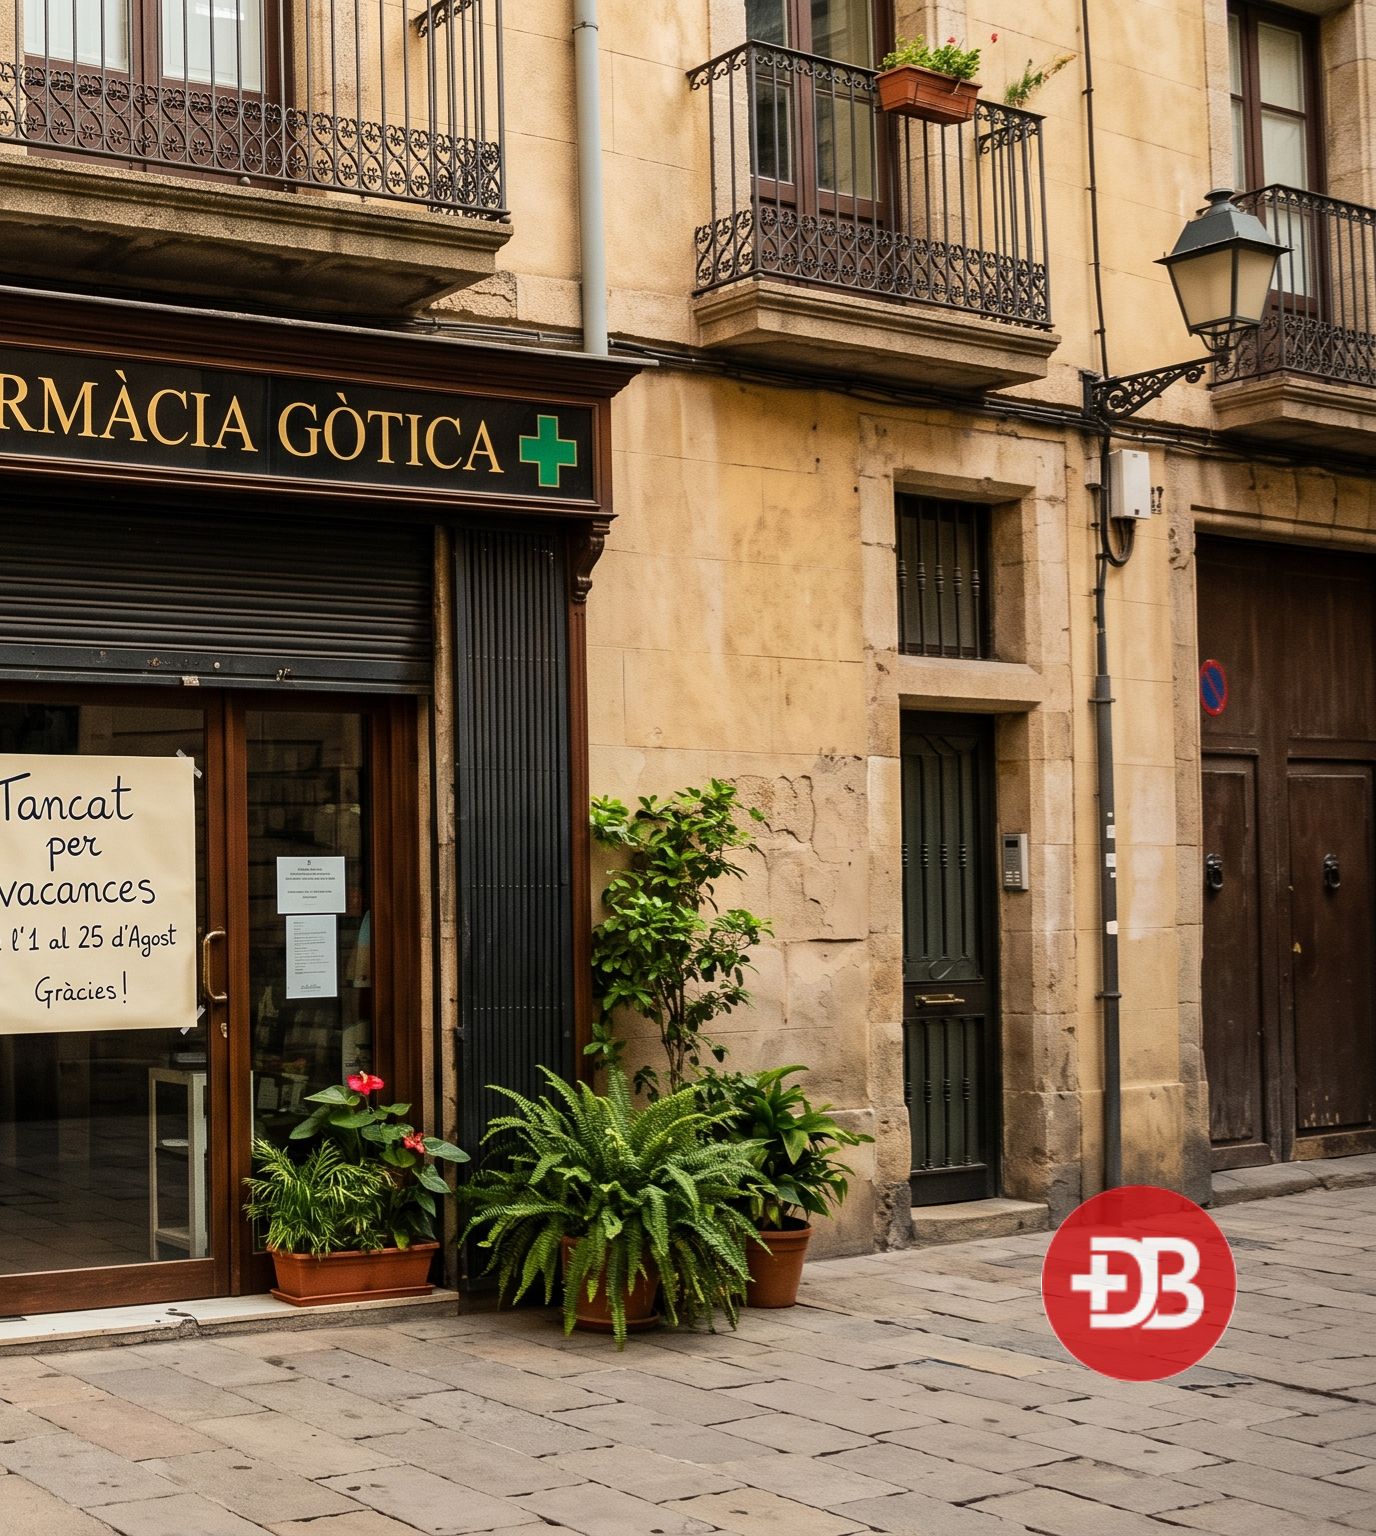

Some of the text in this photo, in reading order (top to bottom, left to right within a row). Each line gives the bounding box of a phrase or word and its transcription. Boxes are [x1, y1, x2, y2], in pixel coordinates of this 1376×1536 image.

[278, 391, 505, 474] GÒTICA
[45, 835, 102, 872] per
[12, 926, 40, 951] l'1
[49, 926, 70, 949] al
[78, 925, 104, 949] 25
[111, 923, 177, 958] d'Agost
